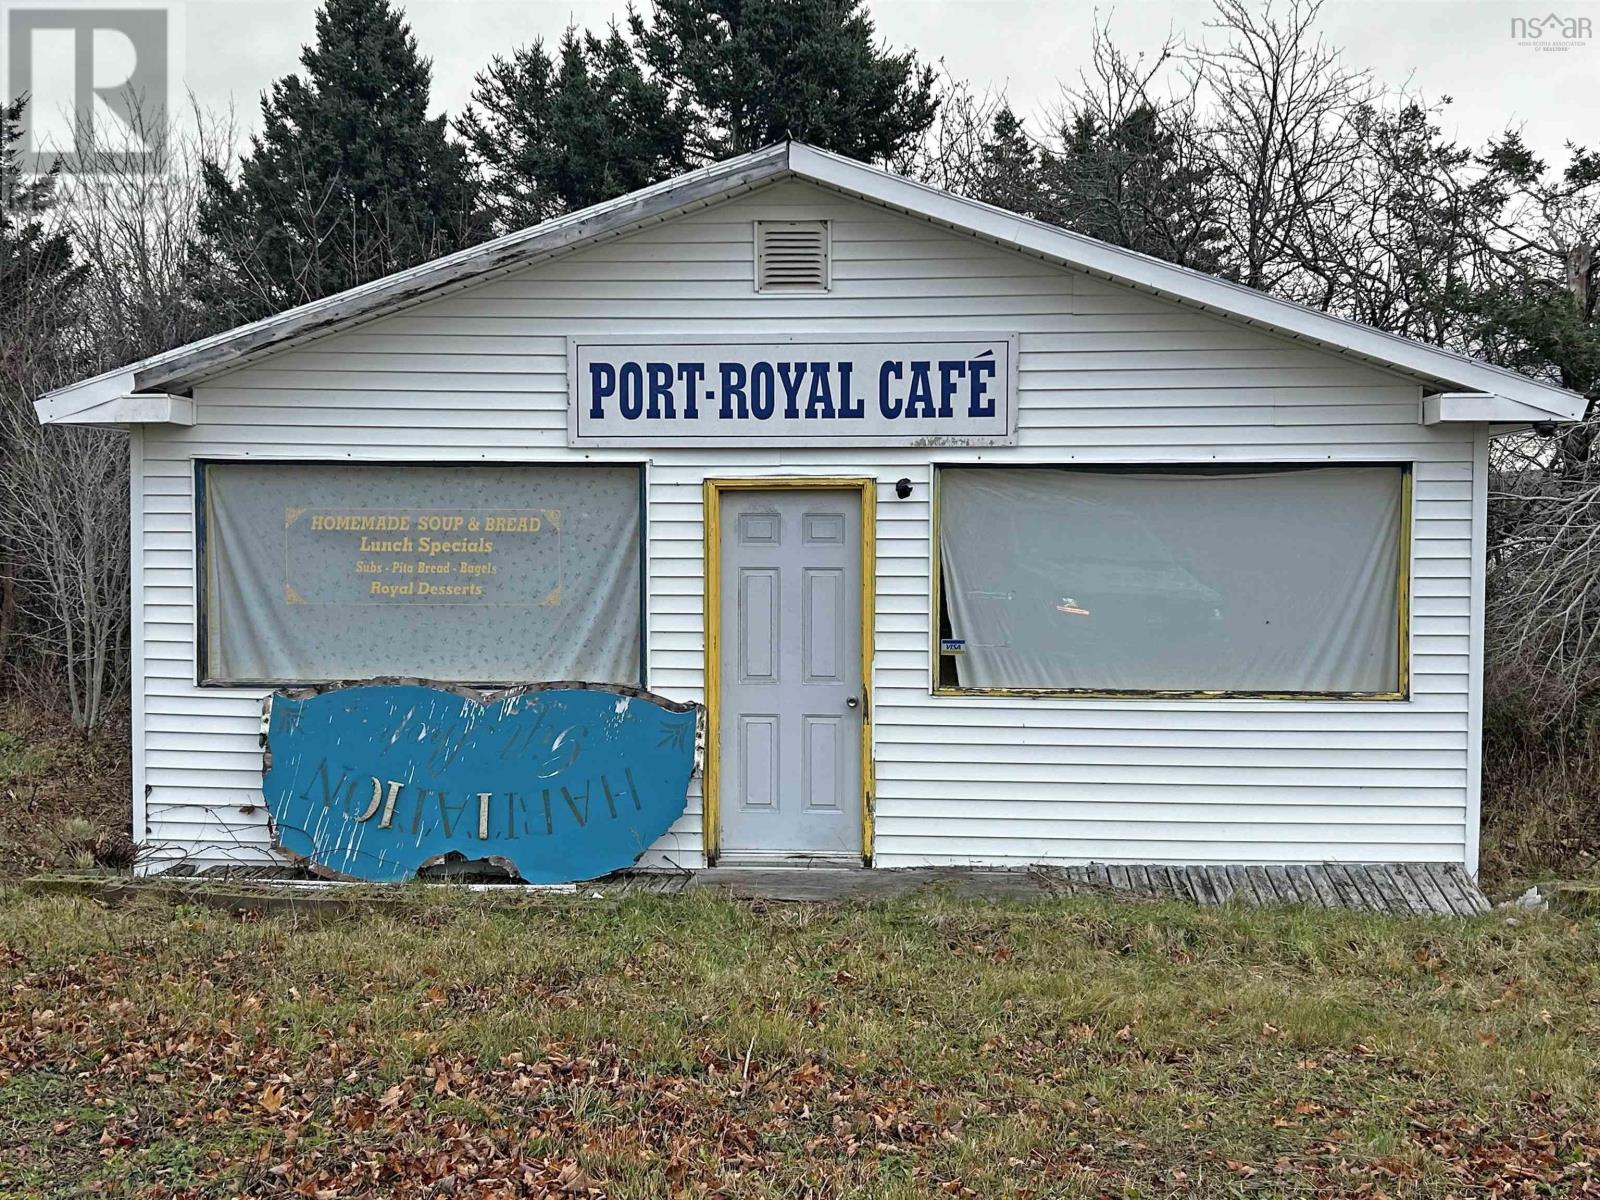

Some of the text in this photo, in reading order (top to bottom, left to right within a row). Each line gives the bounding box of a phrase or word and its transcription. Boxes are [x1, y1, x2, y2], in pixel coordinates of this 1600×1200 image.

[589, 348, 996, 420] PORT-ROYAL CAFÉ
[311, 516, 541, 532] HOMEMADE SOUP & BREAD
[360, 536, 494, 556] Lunch Specials
[356, 561, 382, 573] Subs
[392, 562, 413, 573] Pita
[417, 562, 450, 574] Bread
[460, 562, 497, 576] Bagels
[370, 581, 482, 597] Royal Desserts
